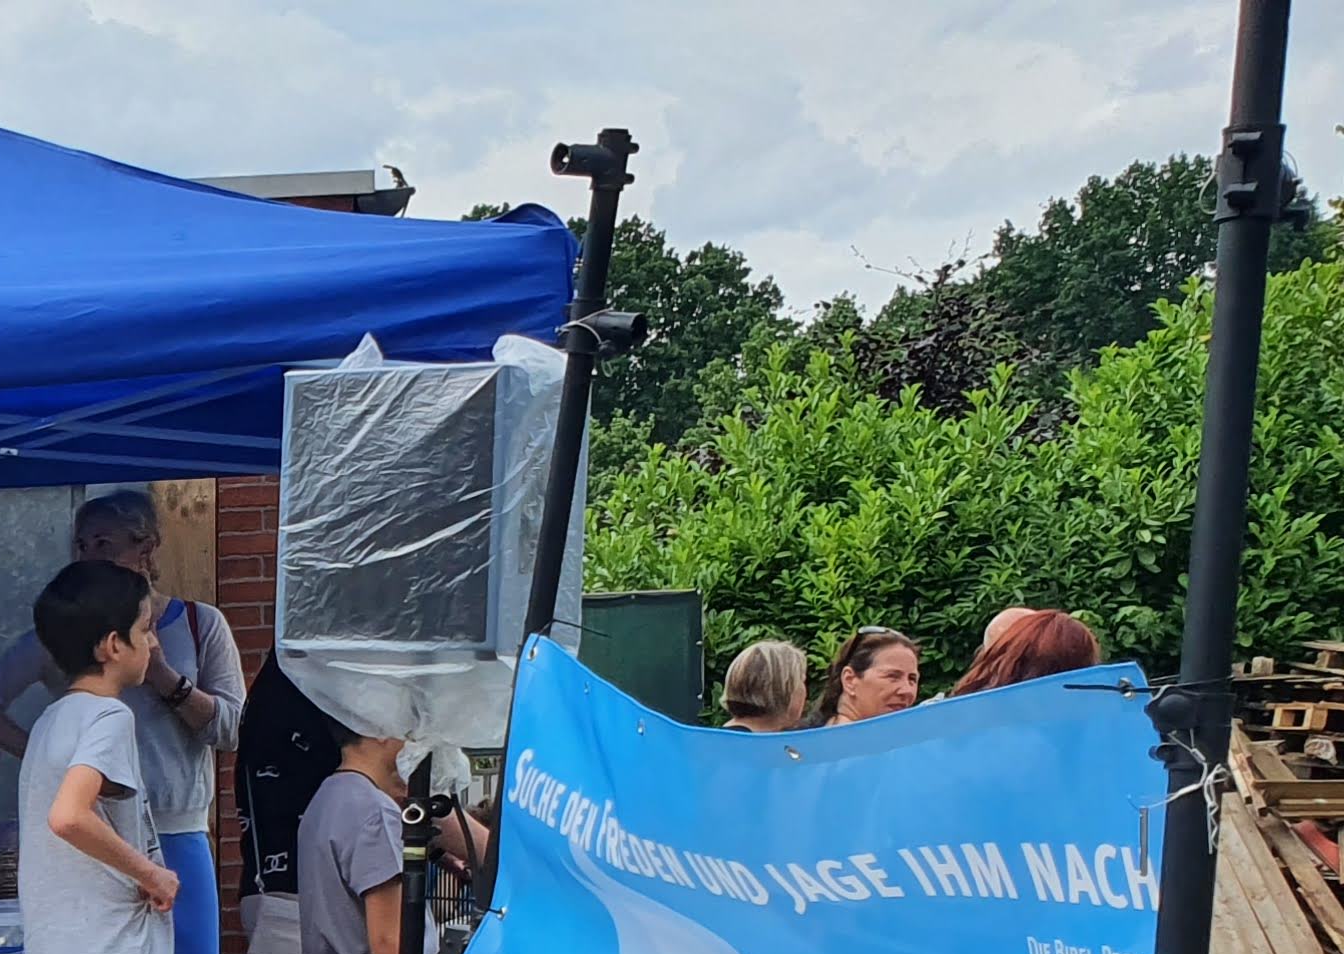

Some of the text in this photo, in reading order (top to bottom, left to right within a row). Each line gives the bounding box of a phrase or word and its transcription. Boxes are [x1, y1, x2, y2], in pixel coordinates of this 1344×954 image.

[507, 748, 567, 828] SUCHE
[683, 850, 769, 906] UND
[764, 852, 906, 916] JAGE
[897, 841, 1020, 900] IHM
[1020, 841, 1162, 912] NACH
